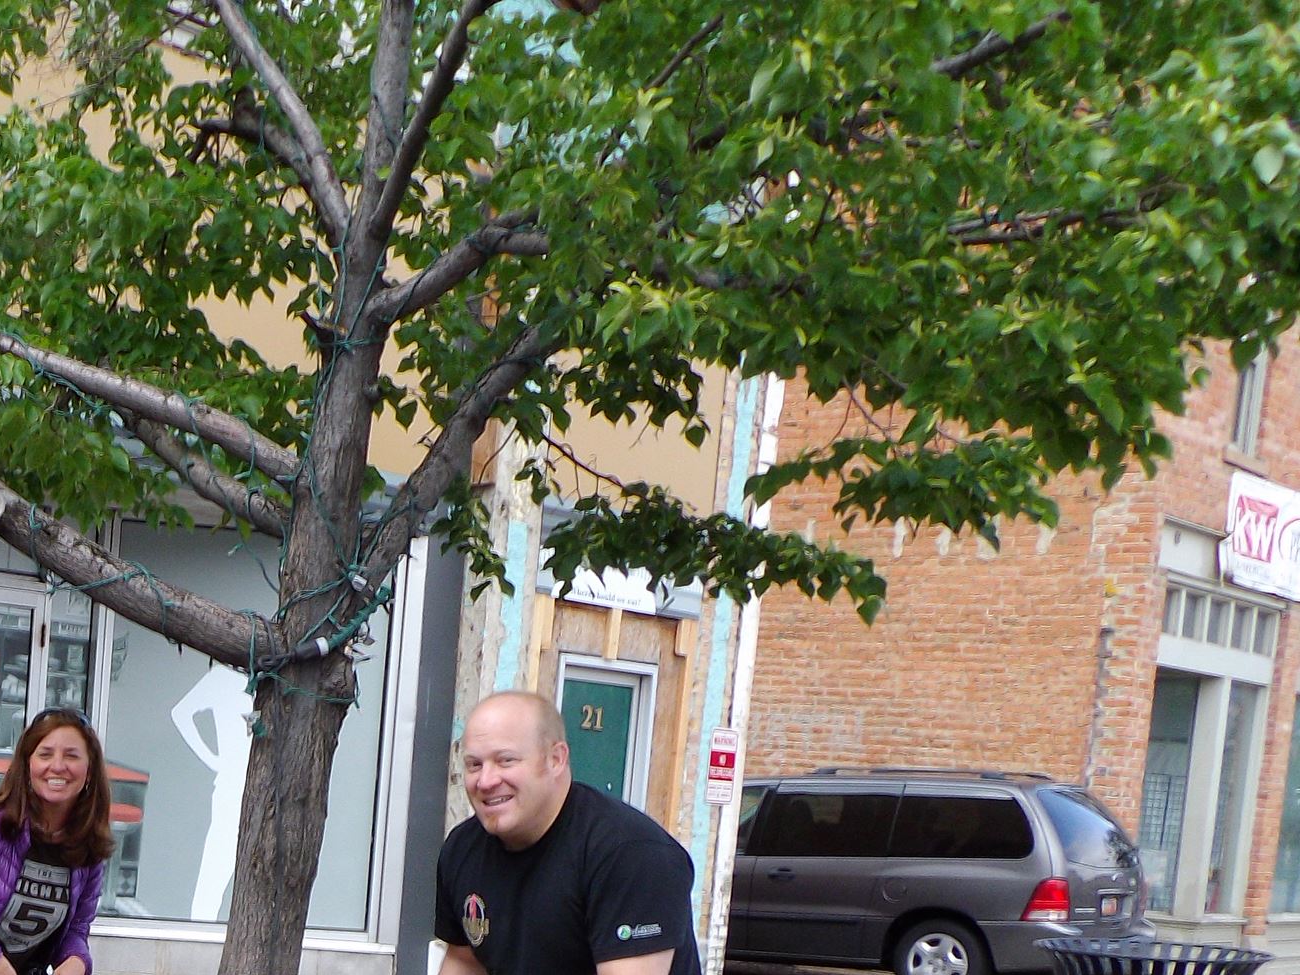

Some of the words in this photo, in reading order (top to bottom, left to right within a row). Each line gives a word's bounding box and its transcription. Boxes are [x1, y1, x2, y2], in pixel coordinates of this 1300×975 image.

[1234, 494, 1277, 563] KW
[581, 704, 604, 731] 21
[8, 902, 56, 937] 5
